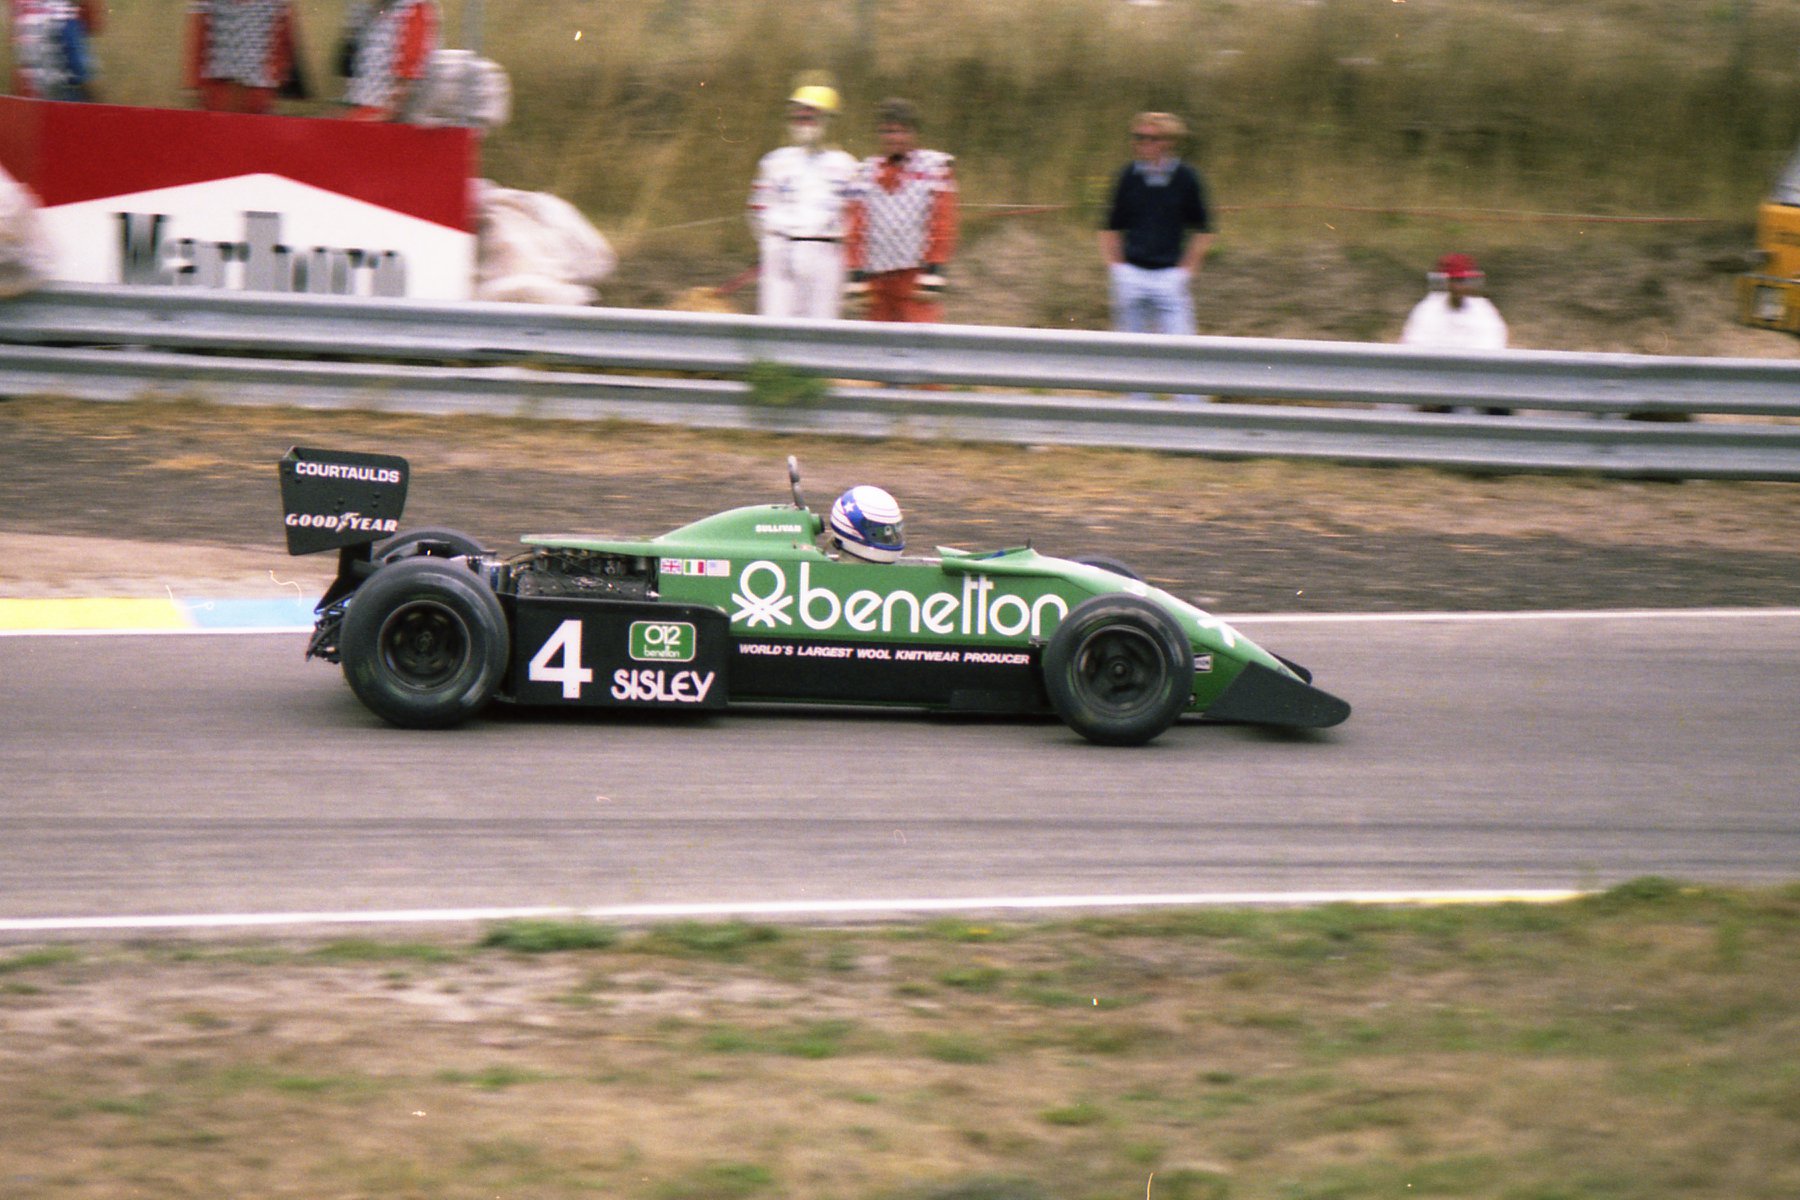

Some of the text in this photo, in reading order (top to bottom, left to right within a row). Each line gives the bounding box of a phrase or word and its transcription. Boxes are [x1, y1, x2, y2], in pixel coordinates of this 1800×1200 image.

[295, 462, 400, 483] COURTAULDS
[799, 561, 1068, 636] benetton
[528, 619, 593, 699] 4
[643, 643, 680, 658] benetton
[739, 643, 1030, 665] WORLD'S LARGEST WOOL KNITWEAR PRODUCER
[610, 668, 715, 702] SISLEY
